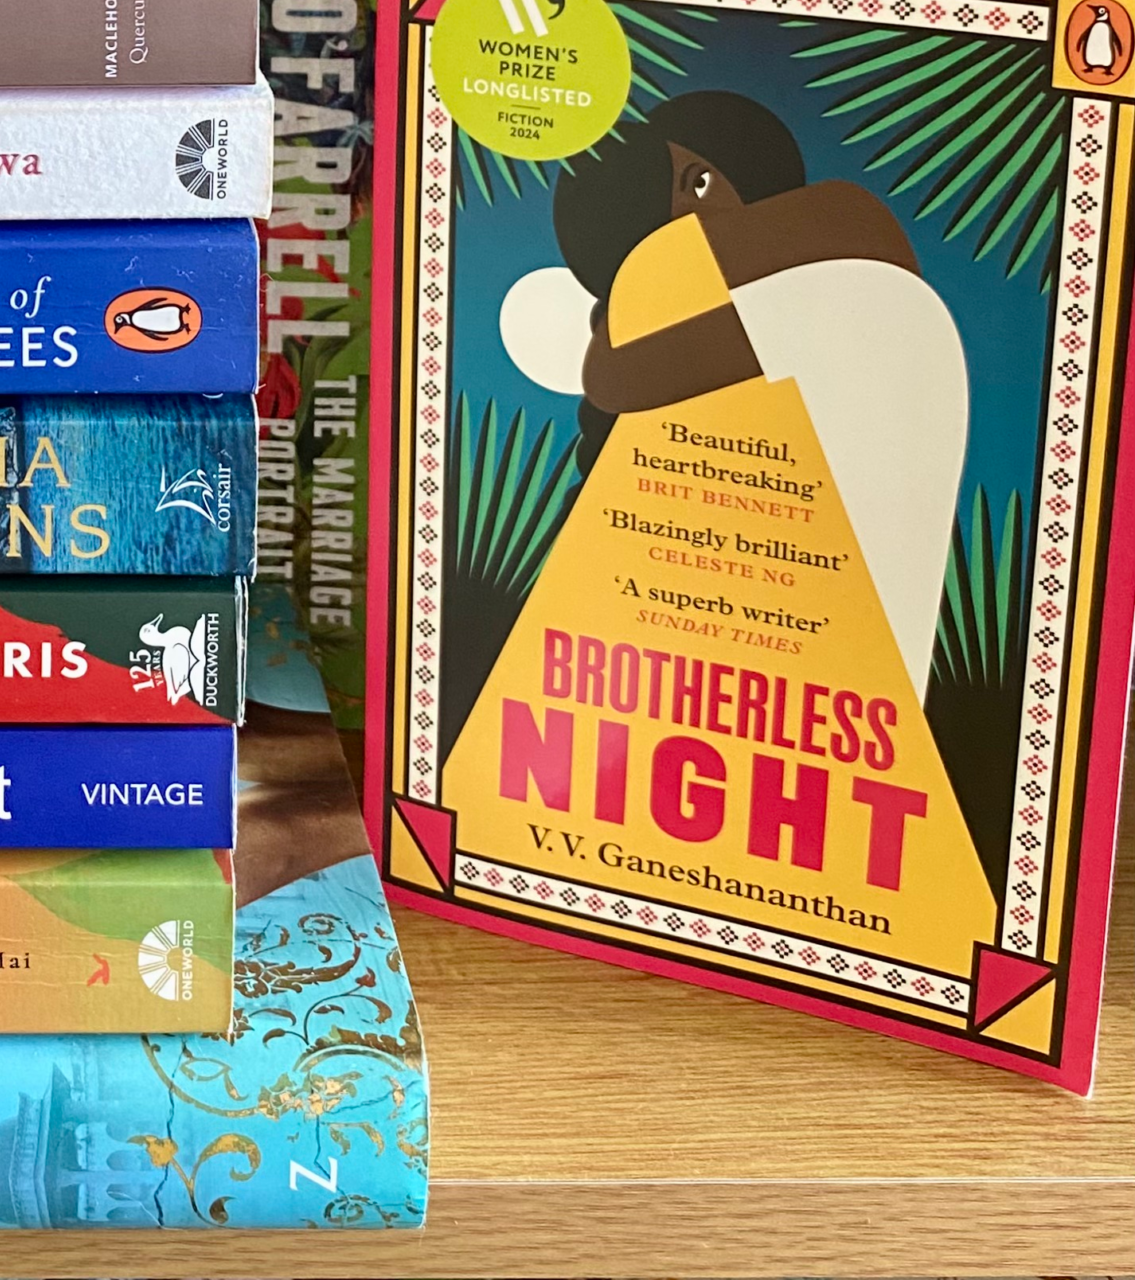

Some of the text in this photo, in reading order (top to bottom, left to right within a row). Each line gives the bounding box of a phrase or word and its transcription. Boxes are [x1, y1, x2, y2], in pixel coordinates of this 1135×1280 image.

[479, 39, 578, 64] WOMEN'S
[499, 61, 556, 81] PRIZE
[463, 77, 592, 107] LONGLISTED
[497, 111, 554, 128] FICTION
[510, 127, 540, 140] 2024
[216, 118, 229, 200] ONEWORLD
[10, 276, 52, 317] of
[216, 463, 232, 532] corsair
[257, 419, 296, 578] PORTRAIT
[310, 375, 356, 628] THE MARRIAGE
[637, 478, 815, 524] BRIT BENNETT
[648, 546, 796, 588] CELESTE NG
[648, 581, 734, 618] superb
[636, 610, 803, 656] SUNDAY TIMES
[130, 649, 154, 693] 125
[153, 650, 165, 686] YEARS
[206, 613, 219, 707] DUCKWORTH
[543, 627, 898, 772] BROTHERLESS
[81, 783, 204, 806] VINTAGE
[499, 697, 928, 892] NIGHT
[597, 841, 892, 936] Ganeshananthan
[182, 919, 194, 1001] ONEWORLD
